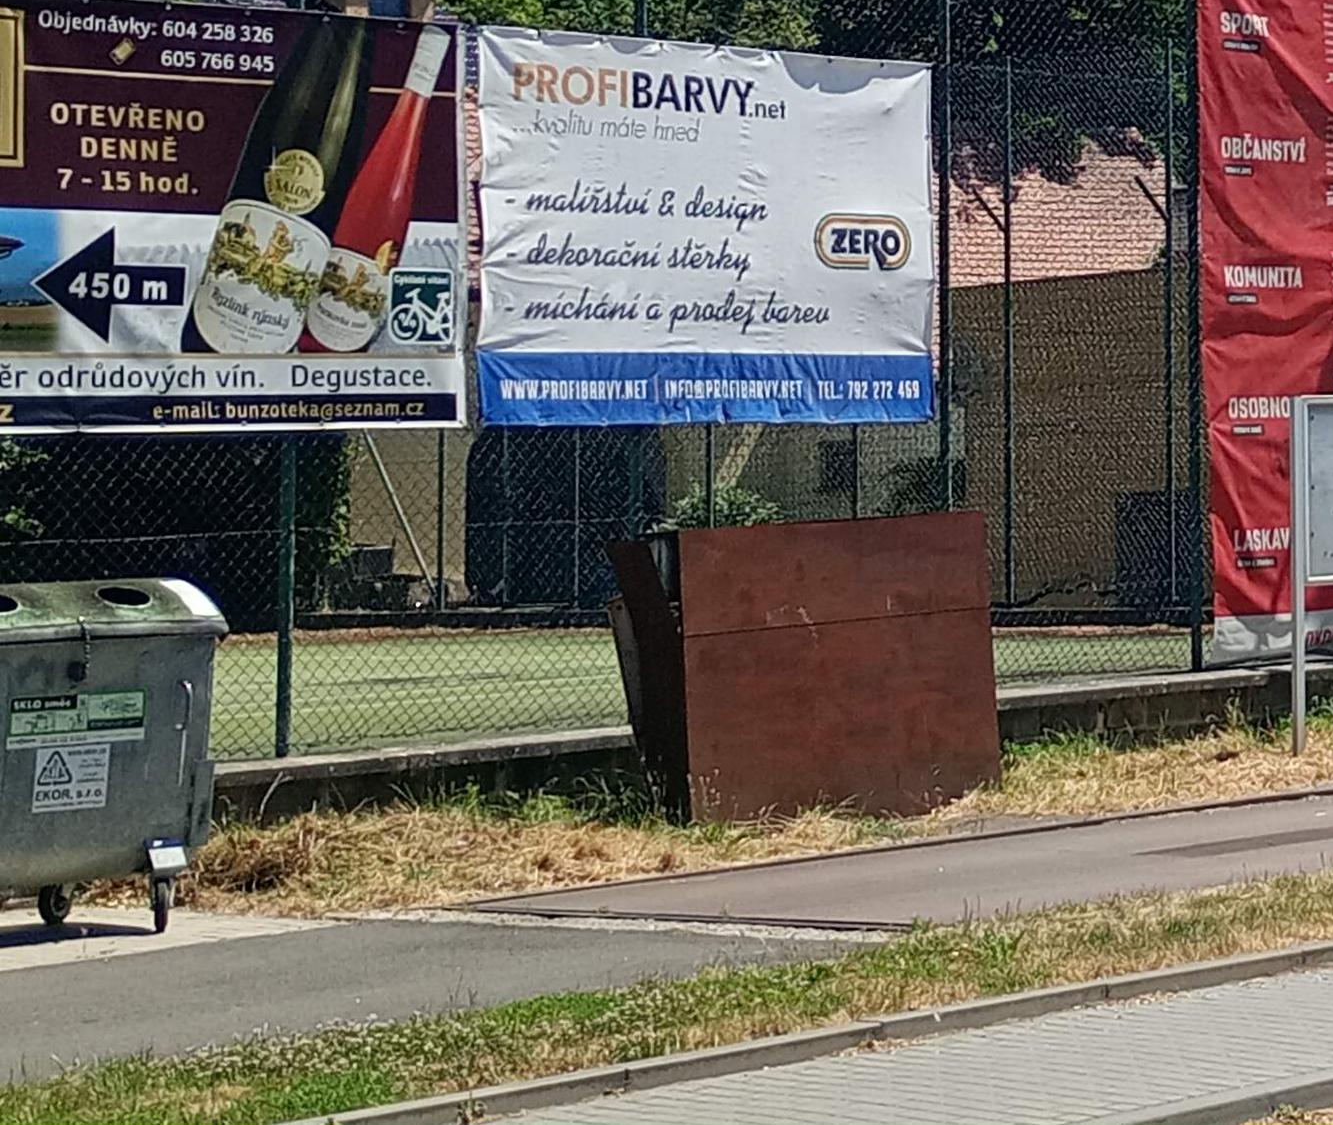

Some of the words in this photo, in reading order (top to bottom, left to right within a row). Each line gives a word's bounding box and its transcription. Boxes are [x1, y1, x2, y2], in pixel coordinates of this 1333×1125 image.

[38, 9, 157, 38] Objednávky:
[162, 20, 197, 38] 604
[202, 23, 236, 41] 258
[240, 26, 274, 44] 326
[1220, 11, 1270, 38] SPORT
[160, 50, 196, 68] 605
[201, 52, 235, 70] 766
[239, 55, 274, 72] 945
[50, 102, 205, 131] OTEVŘENO
[600, 116, 647, 139] máte
[653, 114, 700, 143] hned
[80, 135, 178, 162] DENNĚ
[1220, 133, 1307, 163] OBČANSTVÍ
[57, 168, 73, 190] 7
[101, 170, 131, 192] 15
[139, 171, 199, 195] hod.
[525, 178, 649, 214] malířství
[657, 190, 676, 218] &
[684, 185, 769, 232] design
[526, 232, 662, 270] dekorační
[666, 237, 752, 281] stěrky
[829, 227, 901, 271] ZERO
[68, 272, 131, 300] 450
[143, 278, 168, 301] m
[1223, 265, 1303, 288] KOMUNITA
[523, 288, 639, 322] míchání
[645, 301, 663, 321] a
[669, 290, 756, 335] prodej
[761, 290, 831, 324] barev
[37, 359, 205, 394] odrůdových
[216, 364, 265, 388] vín.
[291, 365, 432, 393] Degustace.
[500, 379, 648, 400] WWW.PROFIBARVY.NET
[664, 378, 804, 400] INFO@PROFIBARVY.NET
[847, 379, 869, 400] 792
[873, 379, 893, 400] 272
[152, 402, 219, 420] e-mail:
[225, 400, 425, 422] bunzoteka@seznam.cz
[13, 699, 42, 711] SKLO
